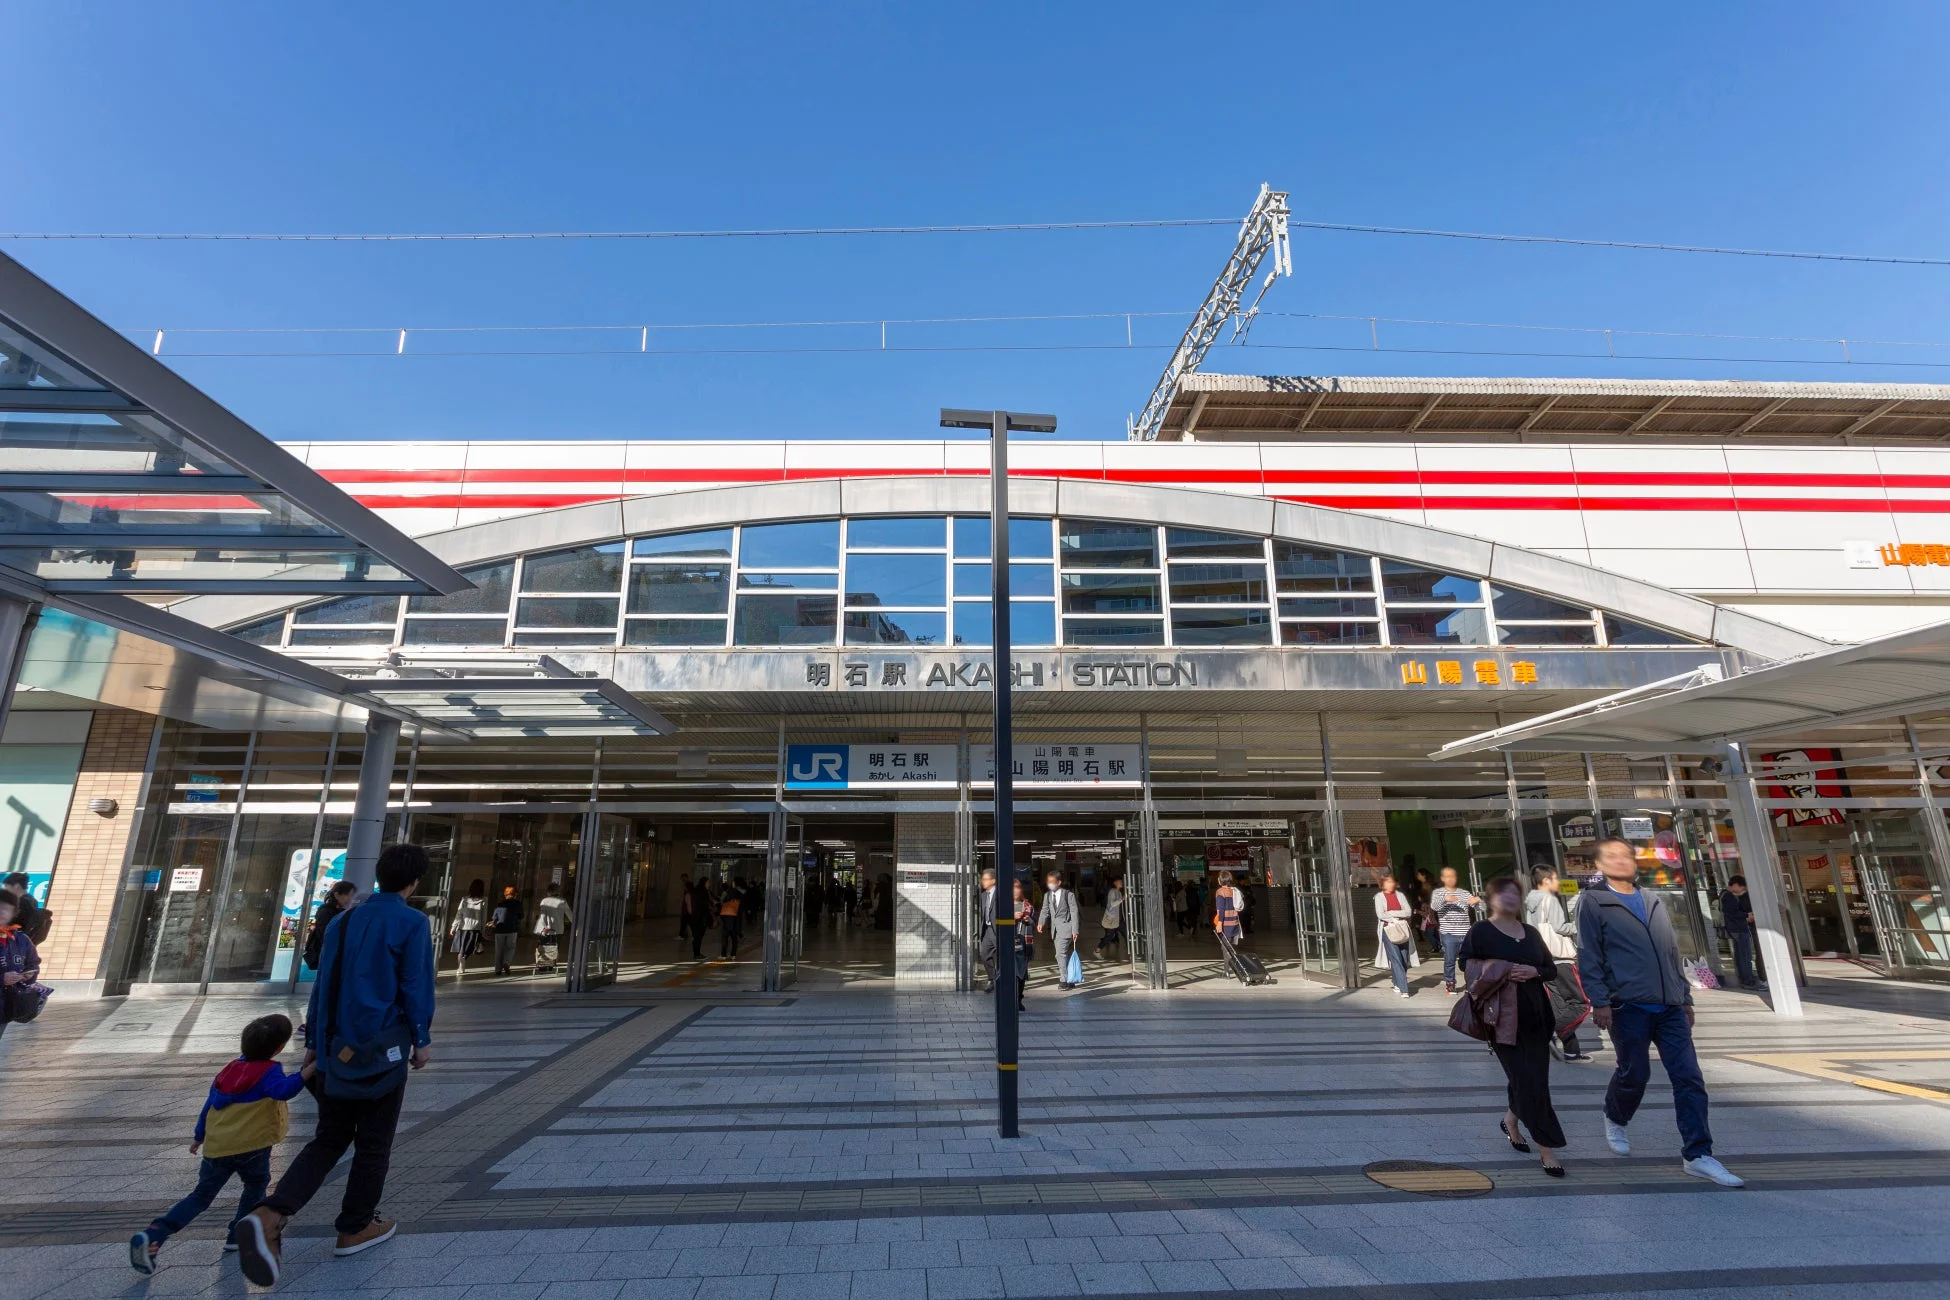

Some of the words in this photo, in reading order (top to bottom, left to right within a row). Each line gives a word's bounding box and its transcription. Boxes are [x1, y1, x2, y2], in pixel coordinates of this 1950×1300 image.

[806, 662, 907, 686] 明石駅
[1072, 662, 1197, 686] STATION
[1401, 660, 1538, 685] 山陽電車
[1035, 746, 1095, 757] 山陽電車
[792, 753, 842, 781] JR
[869, 753, 929, 767] 明石駅
[868, 771, 895, 780] あかし
[902, 771, 937, 780] Akashi
[1011, 760, 1125, 776] 山陽明石駅
[1565, 825, 1595, 837] 御厨神
